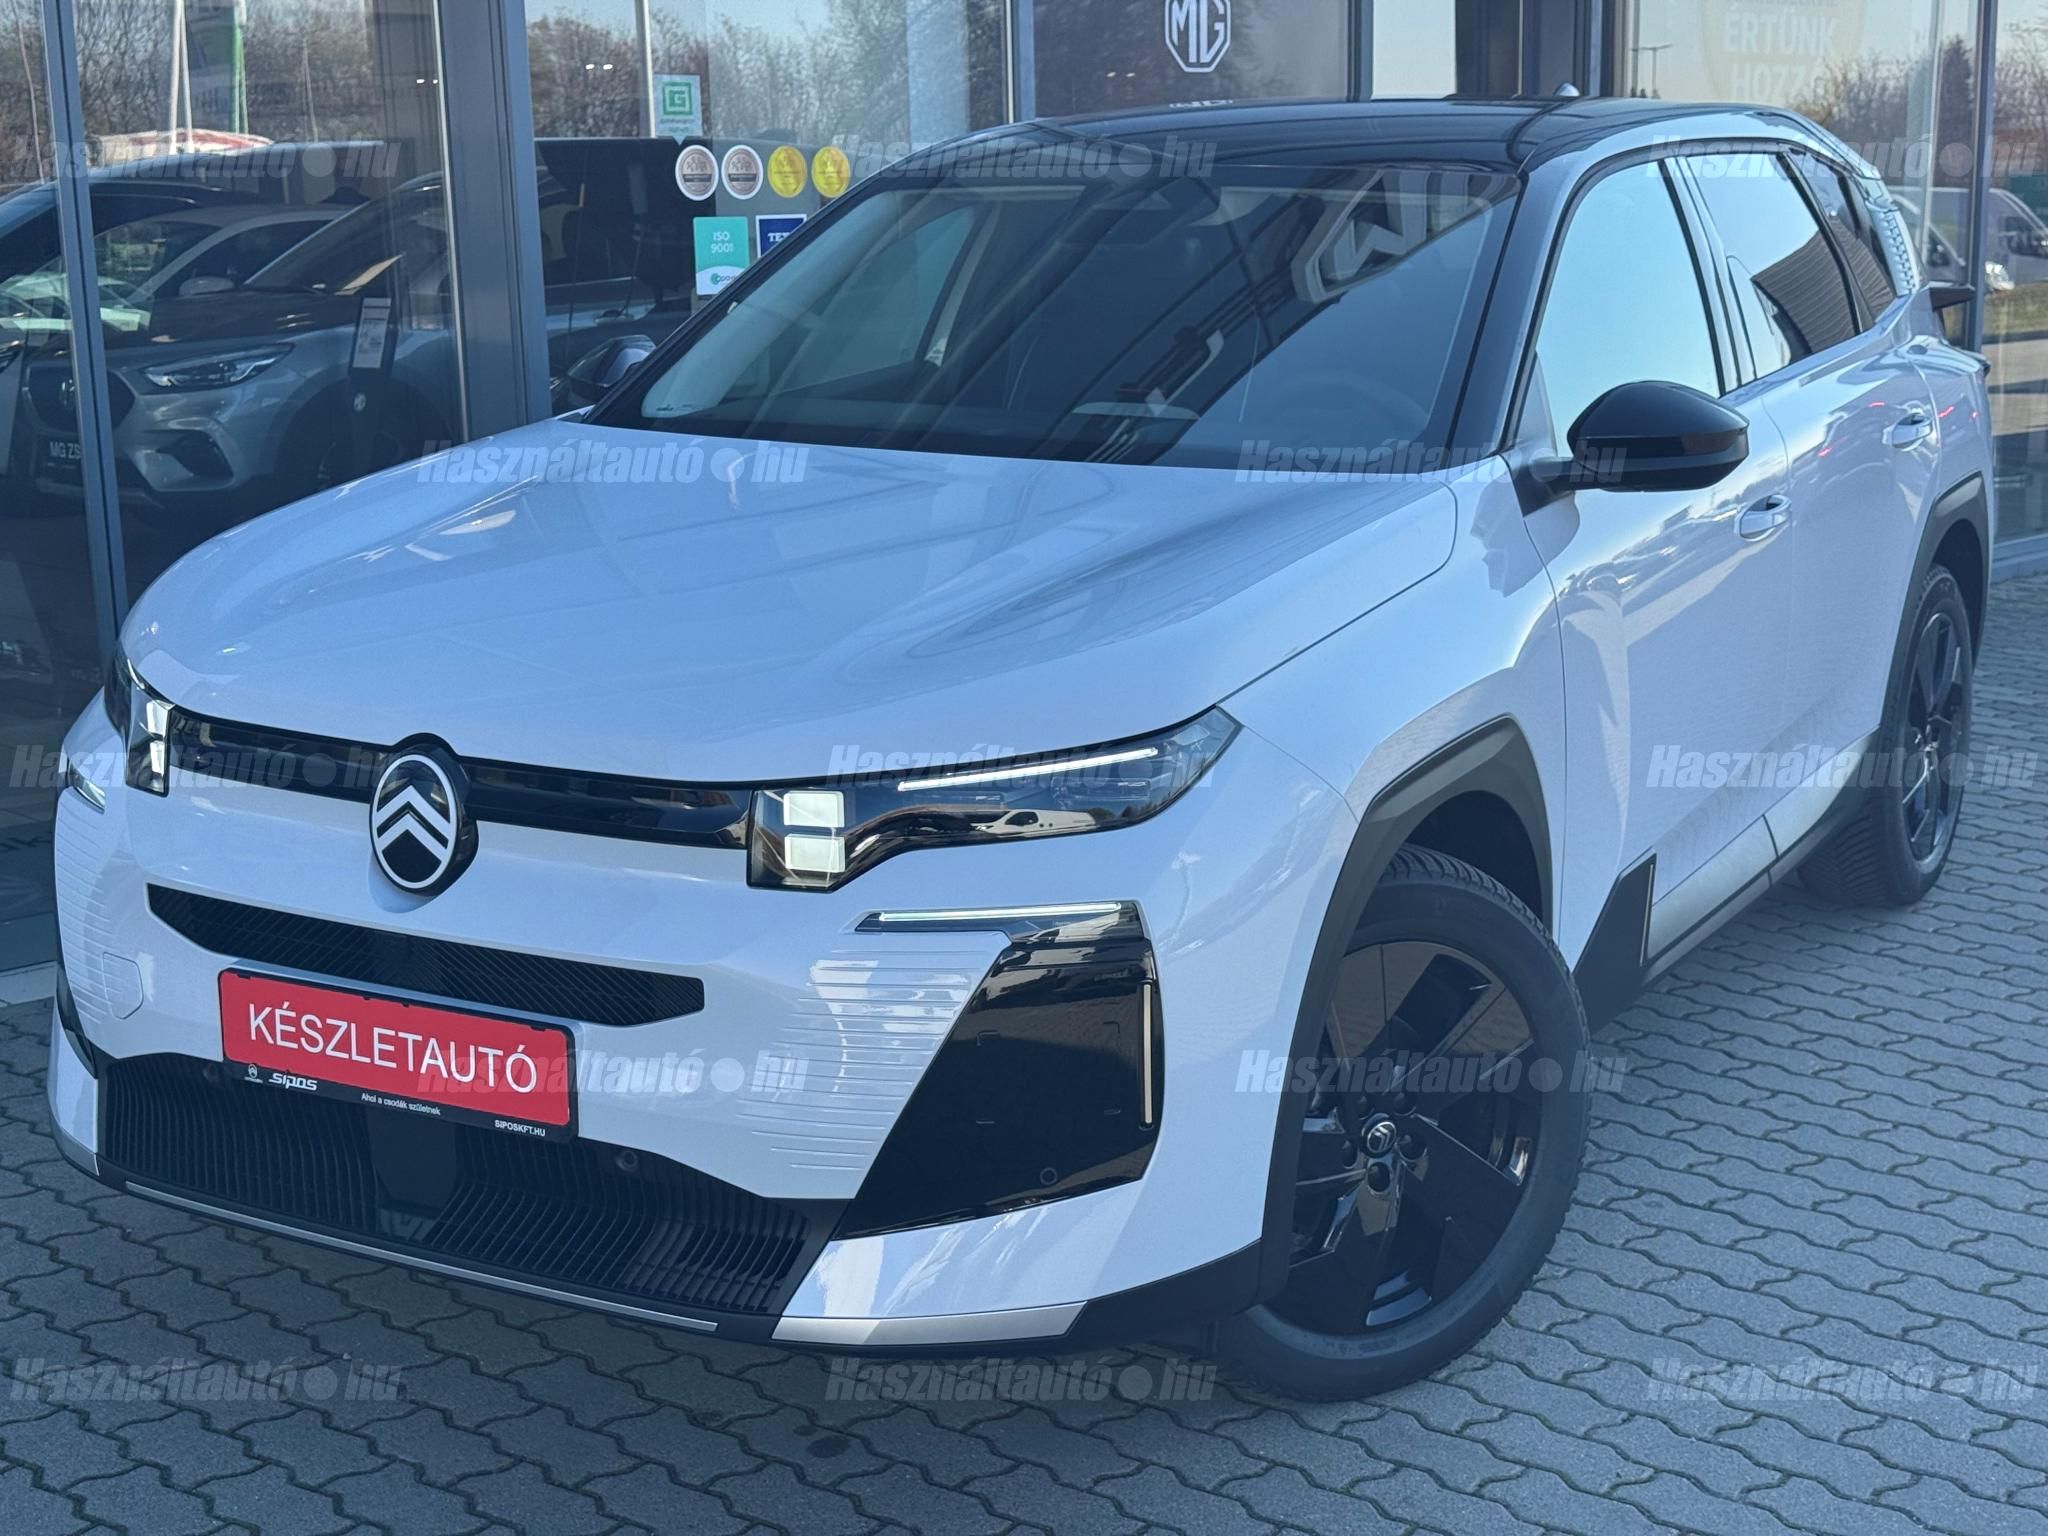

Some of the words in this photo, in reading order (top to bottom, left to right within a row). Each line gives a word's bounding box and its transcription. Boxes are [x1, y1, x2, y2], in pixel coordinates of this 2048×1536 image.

[712, 231, 730, 241] ISO
[710, 242, 734, 253] 9001
[249, 1001, 537, 1093] KÉSZLETAUTÓ
[494, 1119, 546, 1137] SIPOSKFT.HU
